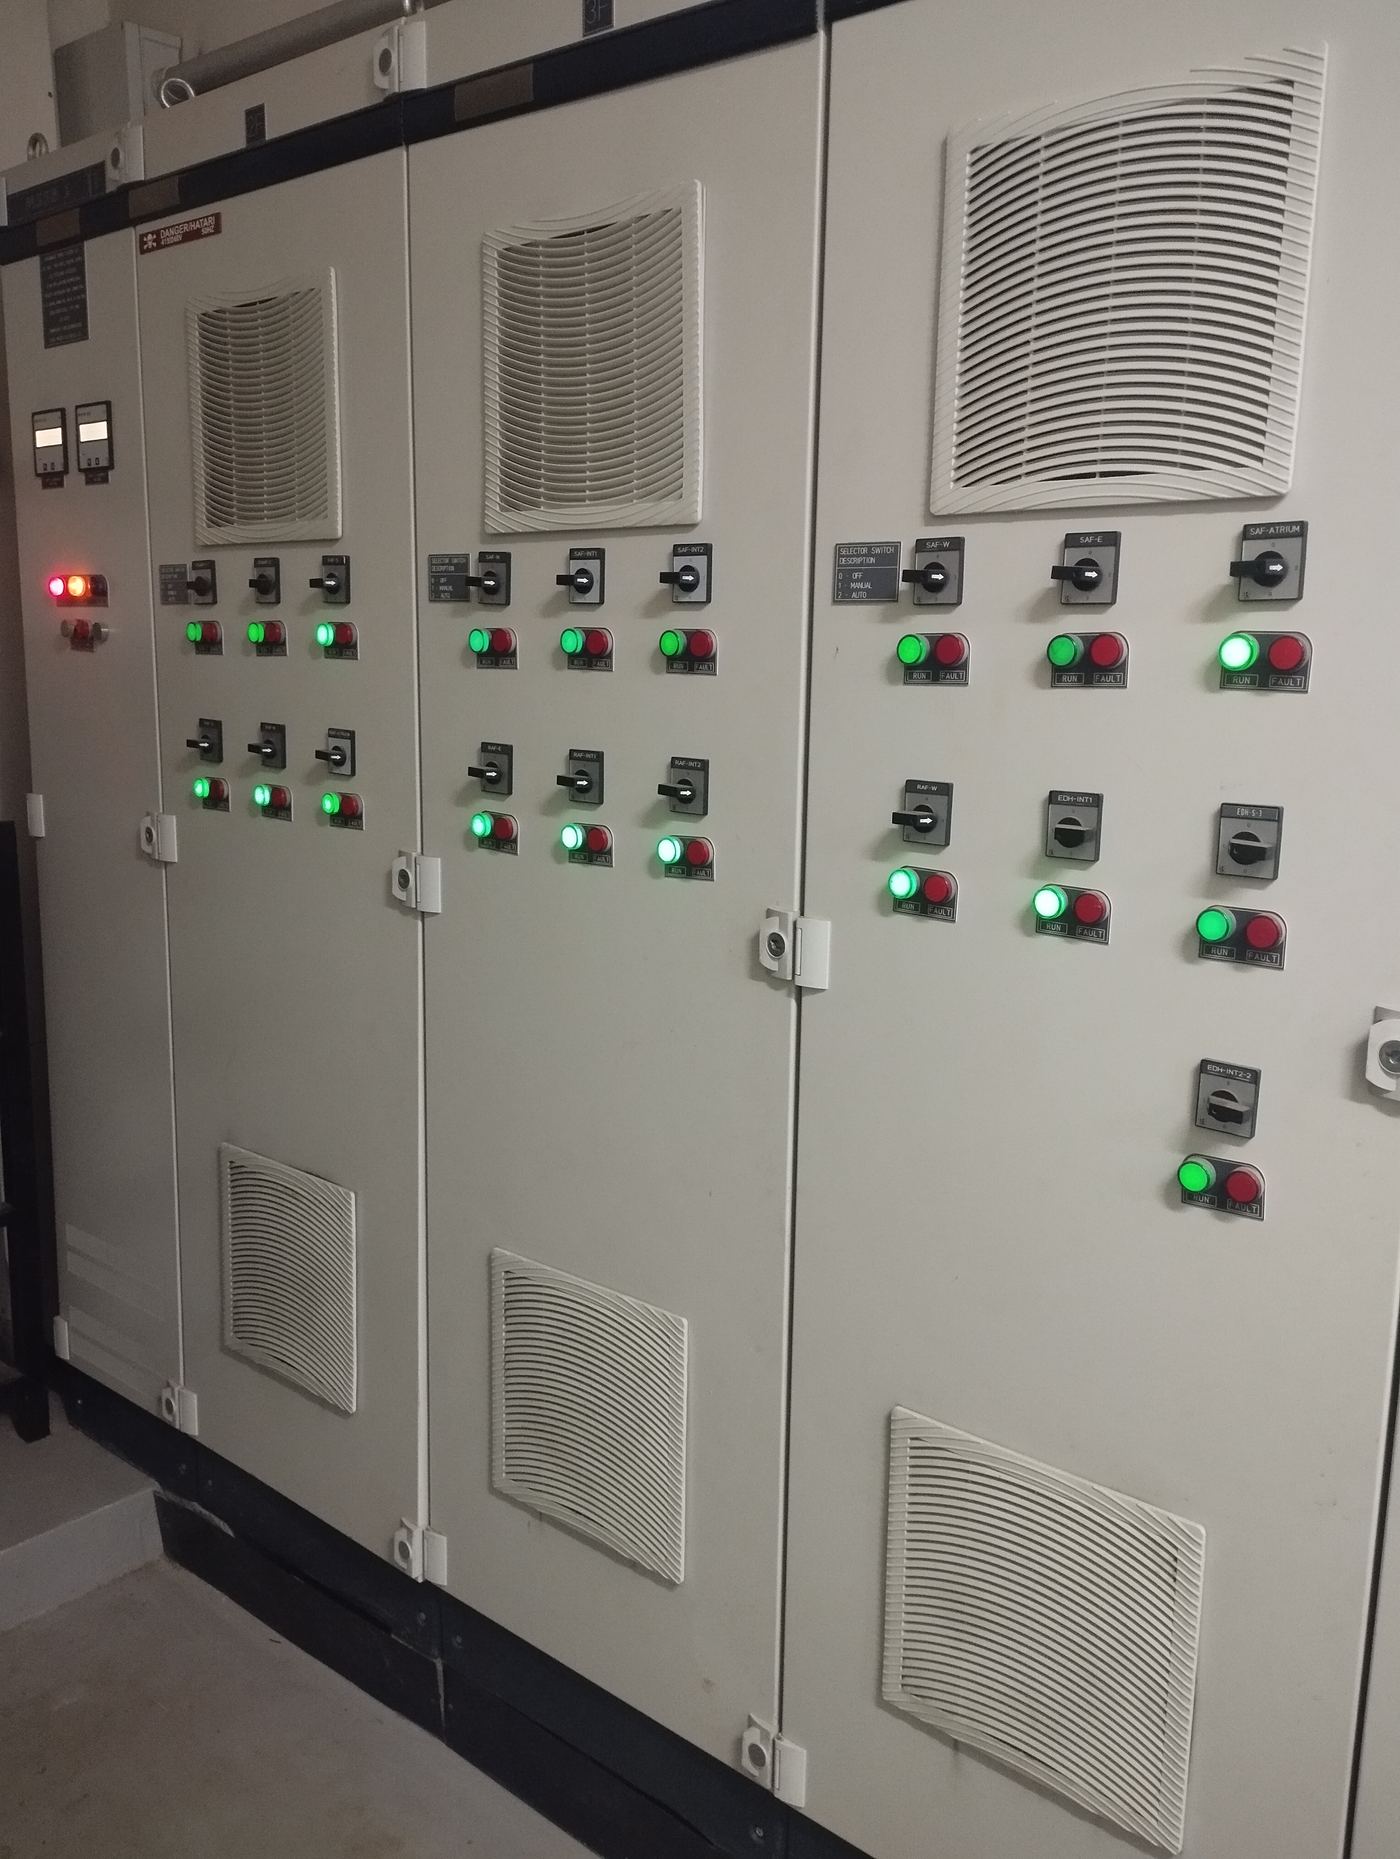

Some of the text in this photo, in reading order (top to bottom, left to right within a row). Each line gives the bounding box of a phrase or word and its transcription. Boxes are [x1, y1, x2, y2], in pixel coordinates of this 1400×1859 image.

[160, 216, 215, 239] DANGER/HATARI
[1249, 525, 1300, 537] SAF-ATRIUM
[1079, 534, 1104, 545] SAF-E
[677, 546, 705, 554] SAF-INT2
[926, 541, 950, 549] SAF-W
[840, 546, 895, 555] SELECTOR SWITCH
[840, 556, 876, 565] DESCRIPTION
[852, 572, 864, 580] OFF
[851, 591, 867, 599] AUTO
[912, 671, 927, 681] RUN
[940, 671, 965, 682] FAULT
[1061, 673, 1078, 683] RUN
[1094, 673, 1121, 684] FAULT
[1231, 674, 1251, 686] RUN
[1271, 675, 1302, 688] FAULT
[916, 784, 938, 792] RAF-W
[929, 905, 952, 917] FAULT
[1046, 922, 1062, 931] RUN
[1078, 927, 1104, 938] FAULT
[1210, 946, 1229, 956] RUN
[1248, 951, 1278, 963] FAULT
[1207, 1064, 1252, 1079] EDH-INT2-2
